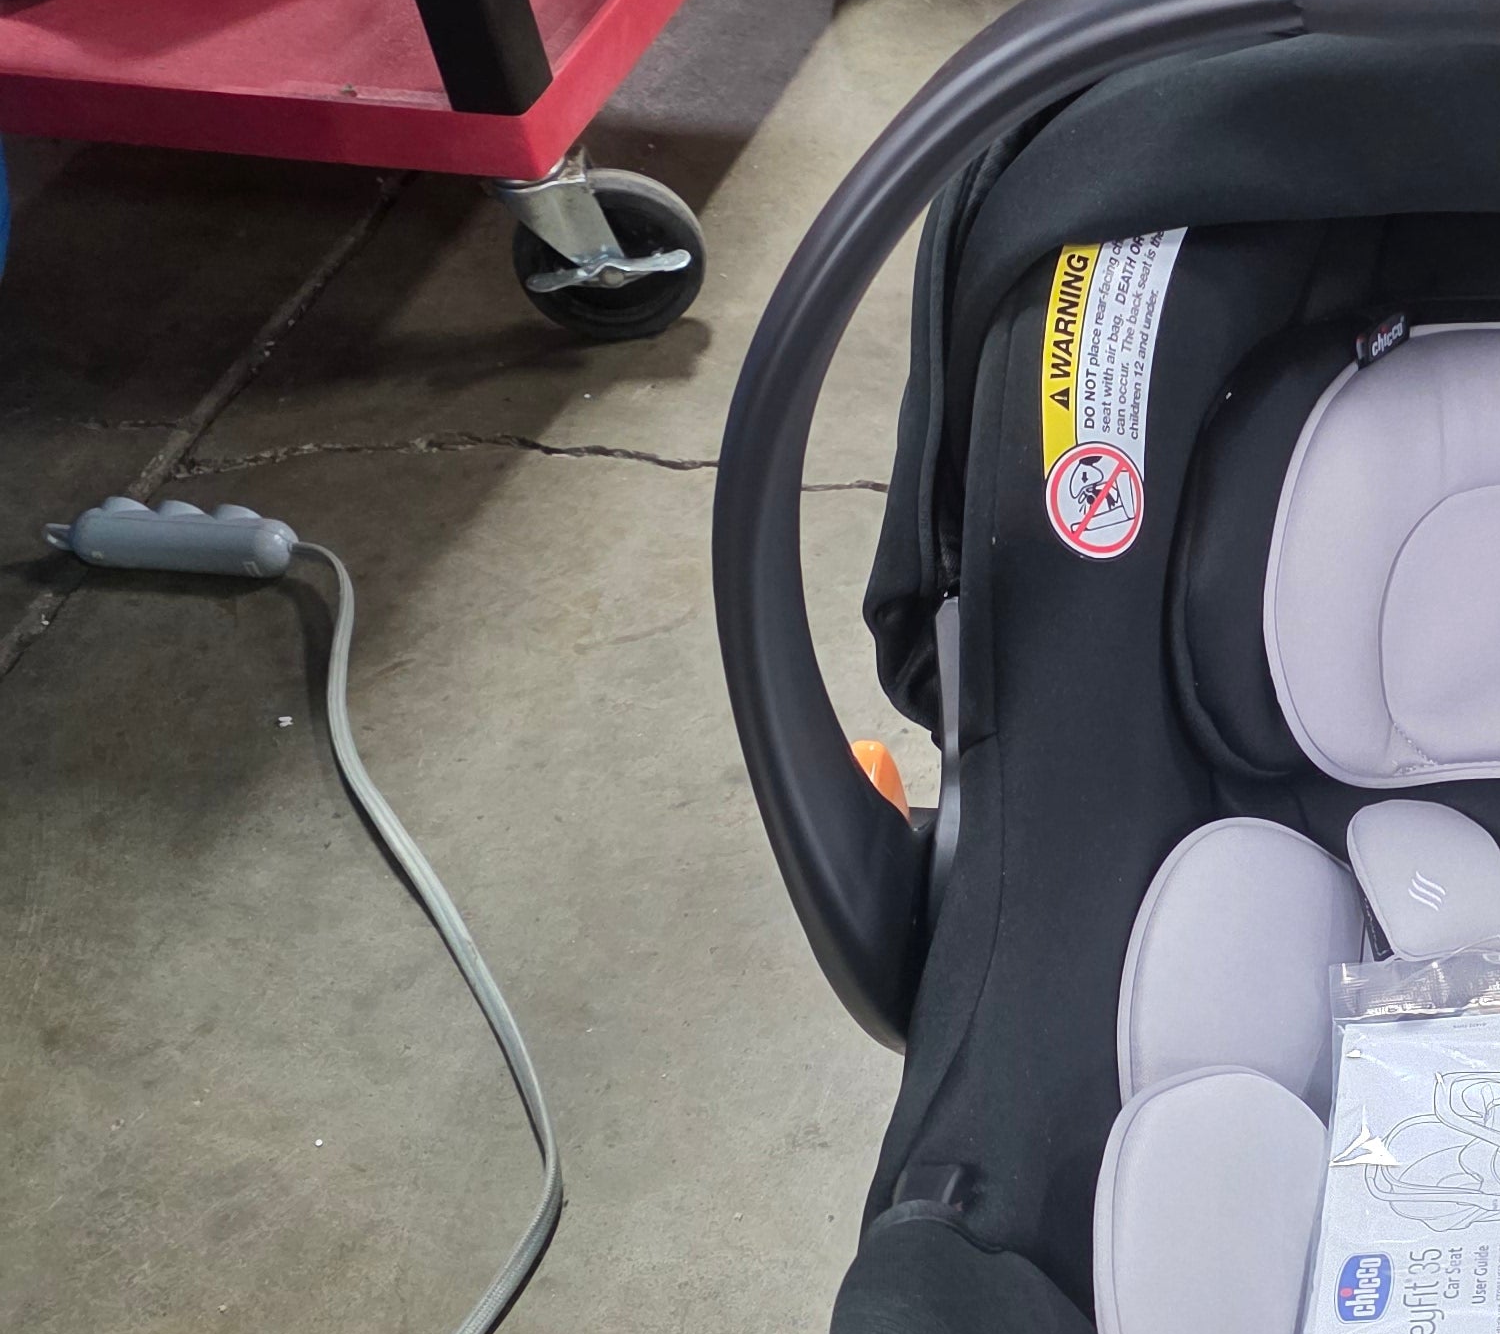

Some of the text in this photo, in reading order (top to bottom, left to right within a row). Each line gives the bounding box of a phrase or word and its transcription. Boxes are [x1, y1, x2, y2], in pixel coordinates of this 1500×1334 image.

[1146, 249, 1156, 261] is
[1096, 257, 1119, 325] rear-facing
[1138, 261, 1152, 289] seat
[1050, 254, 1089, 379] WARNING
[1126, 291, 1142, 324] back
[1088, 328, 1101, 367] place
[1102, 237, 1144, 433] seat with air bag. DEATH OR
[1121, 327, 1134, 352] The
[1371, 323, 1404, 356] chicco
[1119, 362, 1130, 404] occur.
[1130, 290, 1158, 440] children 12 and under.
[1085, 369, 1096, 401] NOT
[1084, 406, 1095, 429] DO
[1117, 408, 1125, 435] can
[1408, 1249, 1442, 1275] 35
[1443, 1247, 1463, 1299] Car Seat
[1472, 1245, 1489, 1304] User Guide
[1339, 1257, 1382, 1317] chicco
